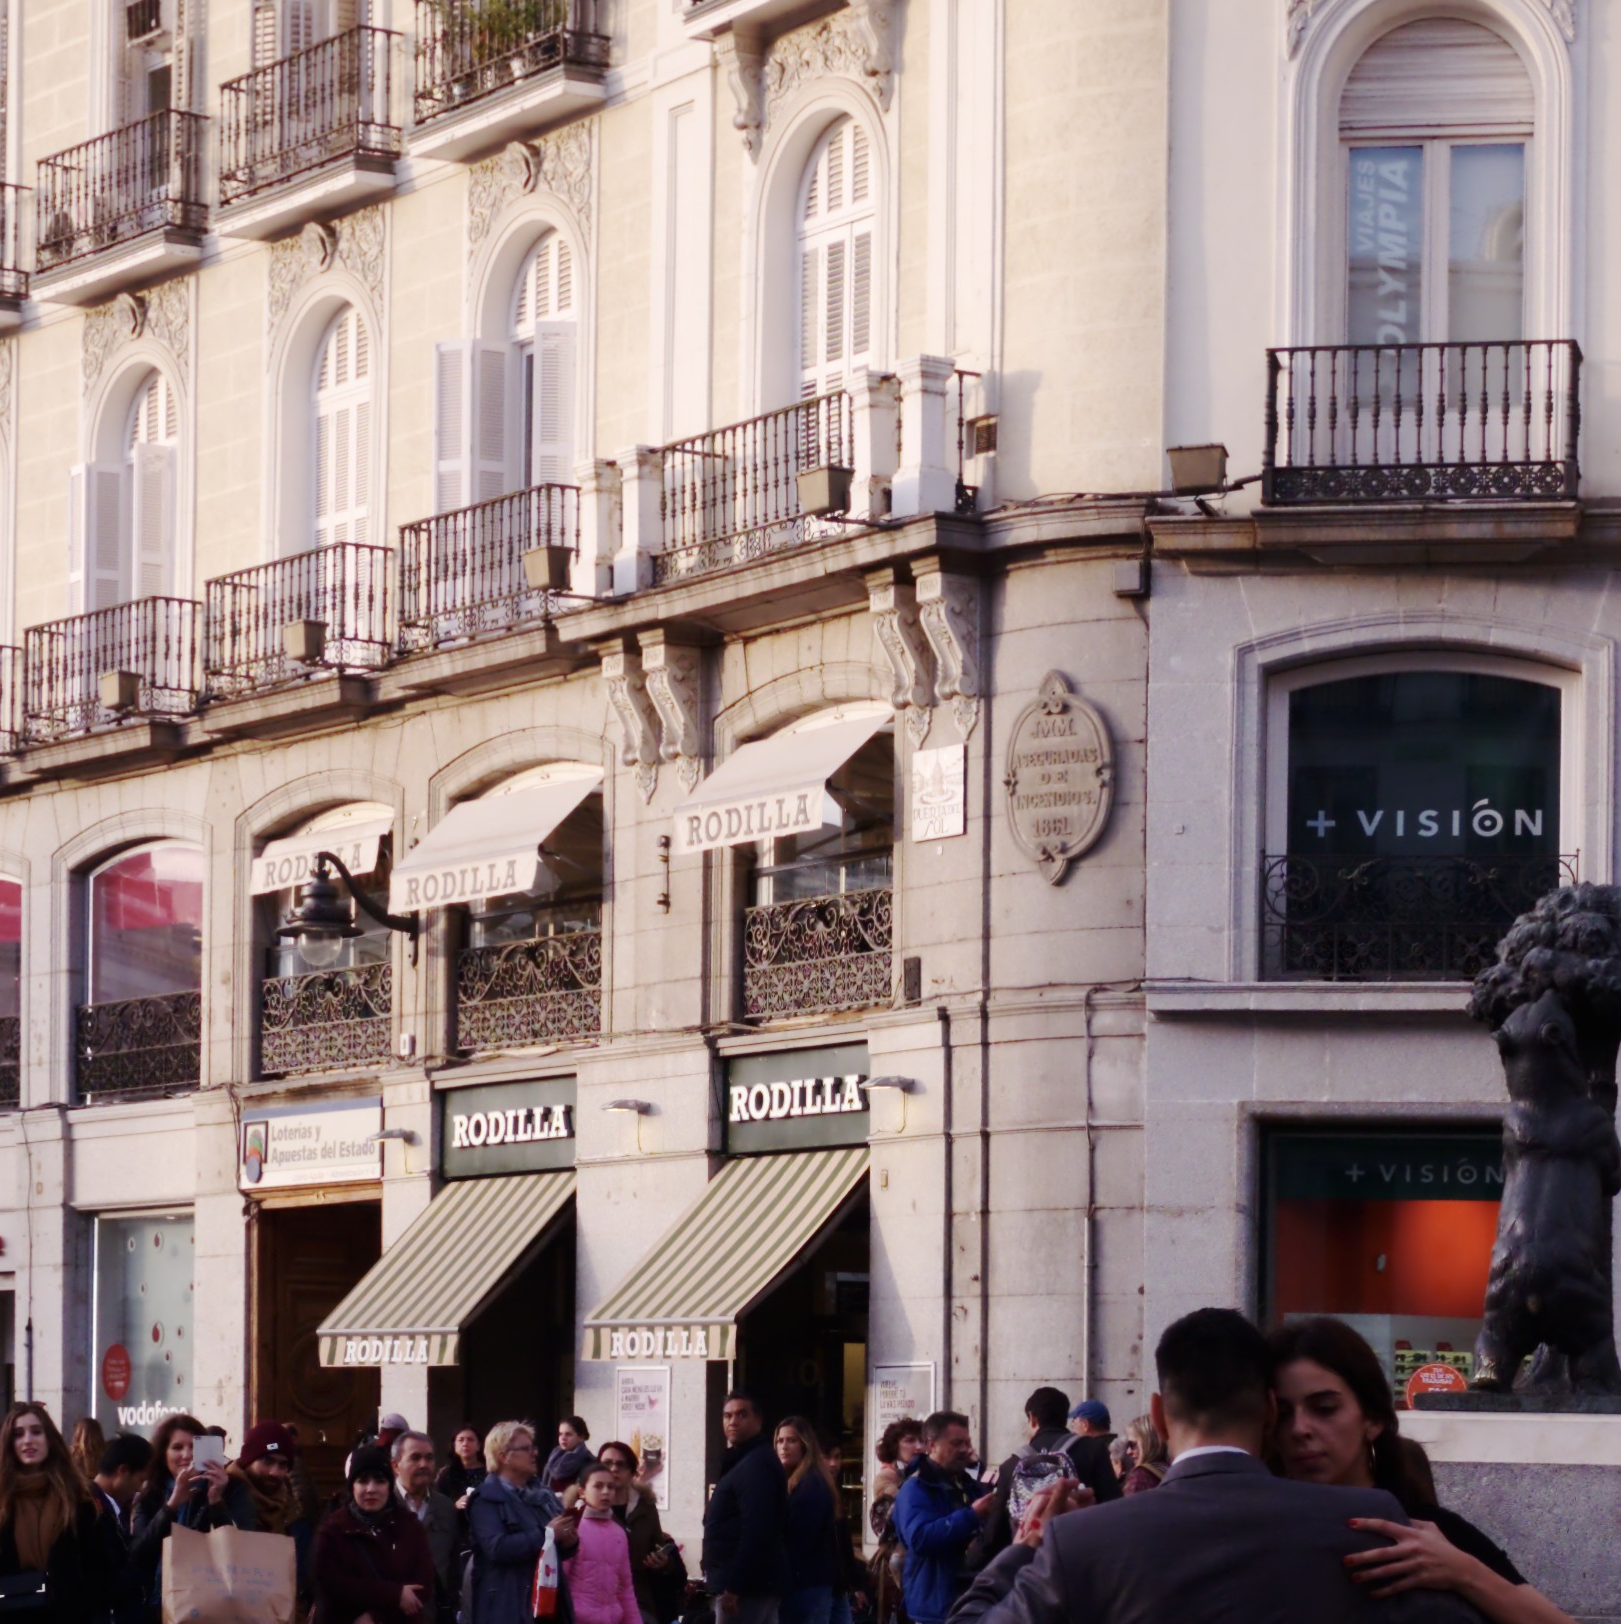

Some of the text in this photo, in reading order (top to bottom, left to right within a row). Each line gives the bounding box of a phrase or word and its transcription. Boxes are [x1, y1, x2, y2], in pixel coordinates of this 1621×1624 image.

[1356, 160, 1376, 251] VIAJES
[1376, 160, 1409, 356] OLYMPIA
[686, 794, 811, 847] RODILLA
[1358, 797, 1543, 838] VISIÓN
[404, 859, 518, 907] RODILLA
[729, 1074, 864, 1122] RODILLA
[315, 1125, 322, 1143] y
[451, 1104, 569, 1148] RODILLA
[271, 1137, 375, 1167] Apuestas del Estado
[344, 1339, 428, 1363] RODILLA
[610, 1331, 708, 1357] RODILLA
